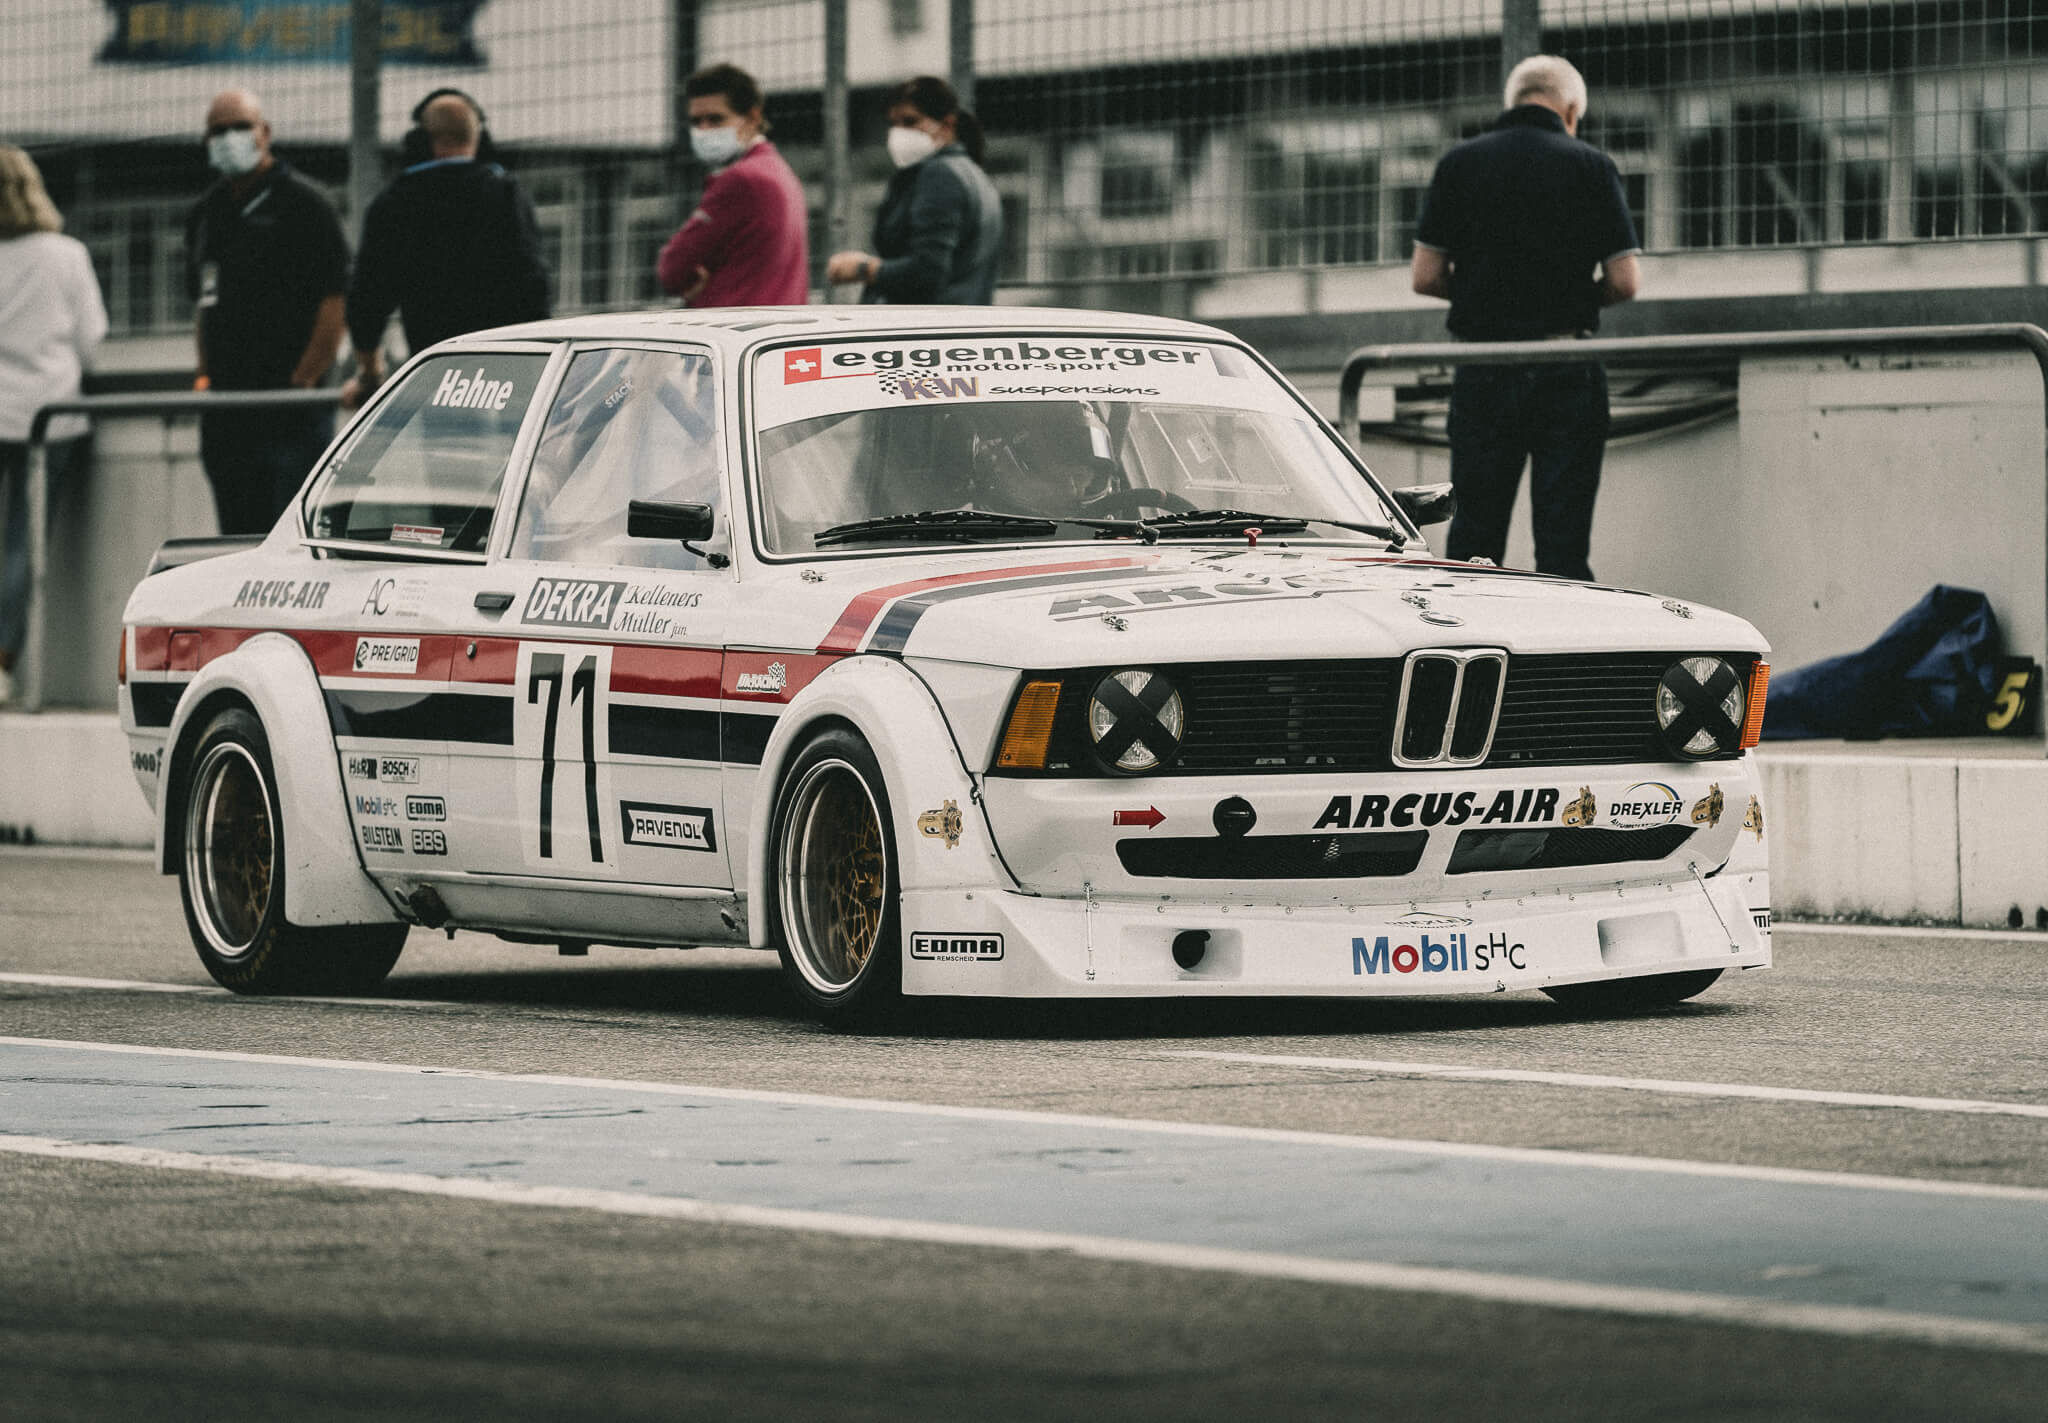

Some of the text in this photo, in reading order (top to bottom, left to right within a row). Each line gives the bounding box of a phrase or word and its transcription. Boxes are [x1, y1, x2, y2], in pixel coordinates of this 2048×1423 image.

[832, 342, 1200, 370] eggenberger
[946, 360, 1119, 374] motor-sport
[432, 367, 514, 411] Hahne
[900, 376, 1160, 400] KW suspensions
[232, 580, 331, 608] ARCUS-AIR
[526, 580, 616, 624] DEKRA
[624, 584, 703, 608] Kelleners
[371, 644, 418, 663] PRE/GRID
[1987, 671, 2029, 730] 5
[382, 760, 410, 776] BOSCH
[527, 652, 604, 863] 71
[356, 795, 382, 815] Mobil
[1312, 788, 1560, 829] ARCUS-AIR
[1610, 802, 1683, 819] DREXLER
[362, 825, 403, 847] BILSTEIN
[635, 818, 702, 840] RAVENOL
[412, 829, 448, 855] BBS
[915, 939, 998, 953] EDMA
[1351, 933, 1468, 975] Mobil
